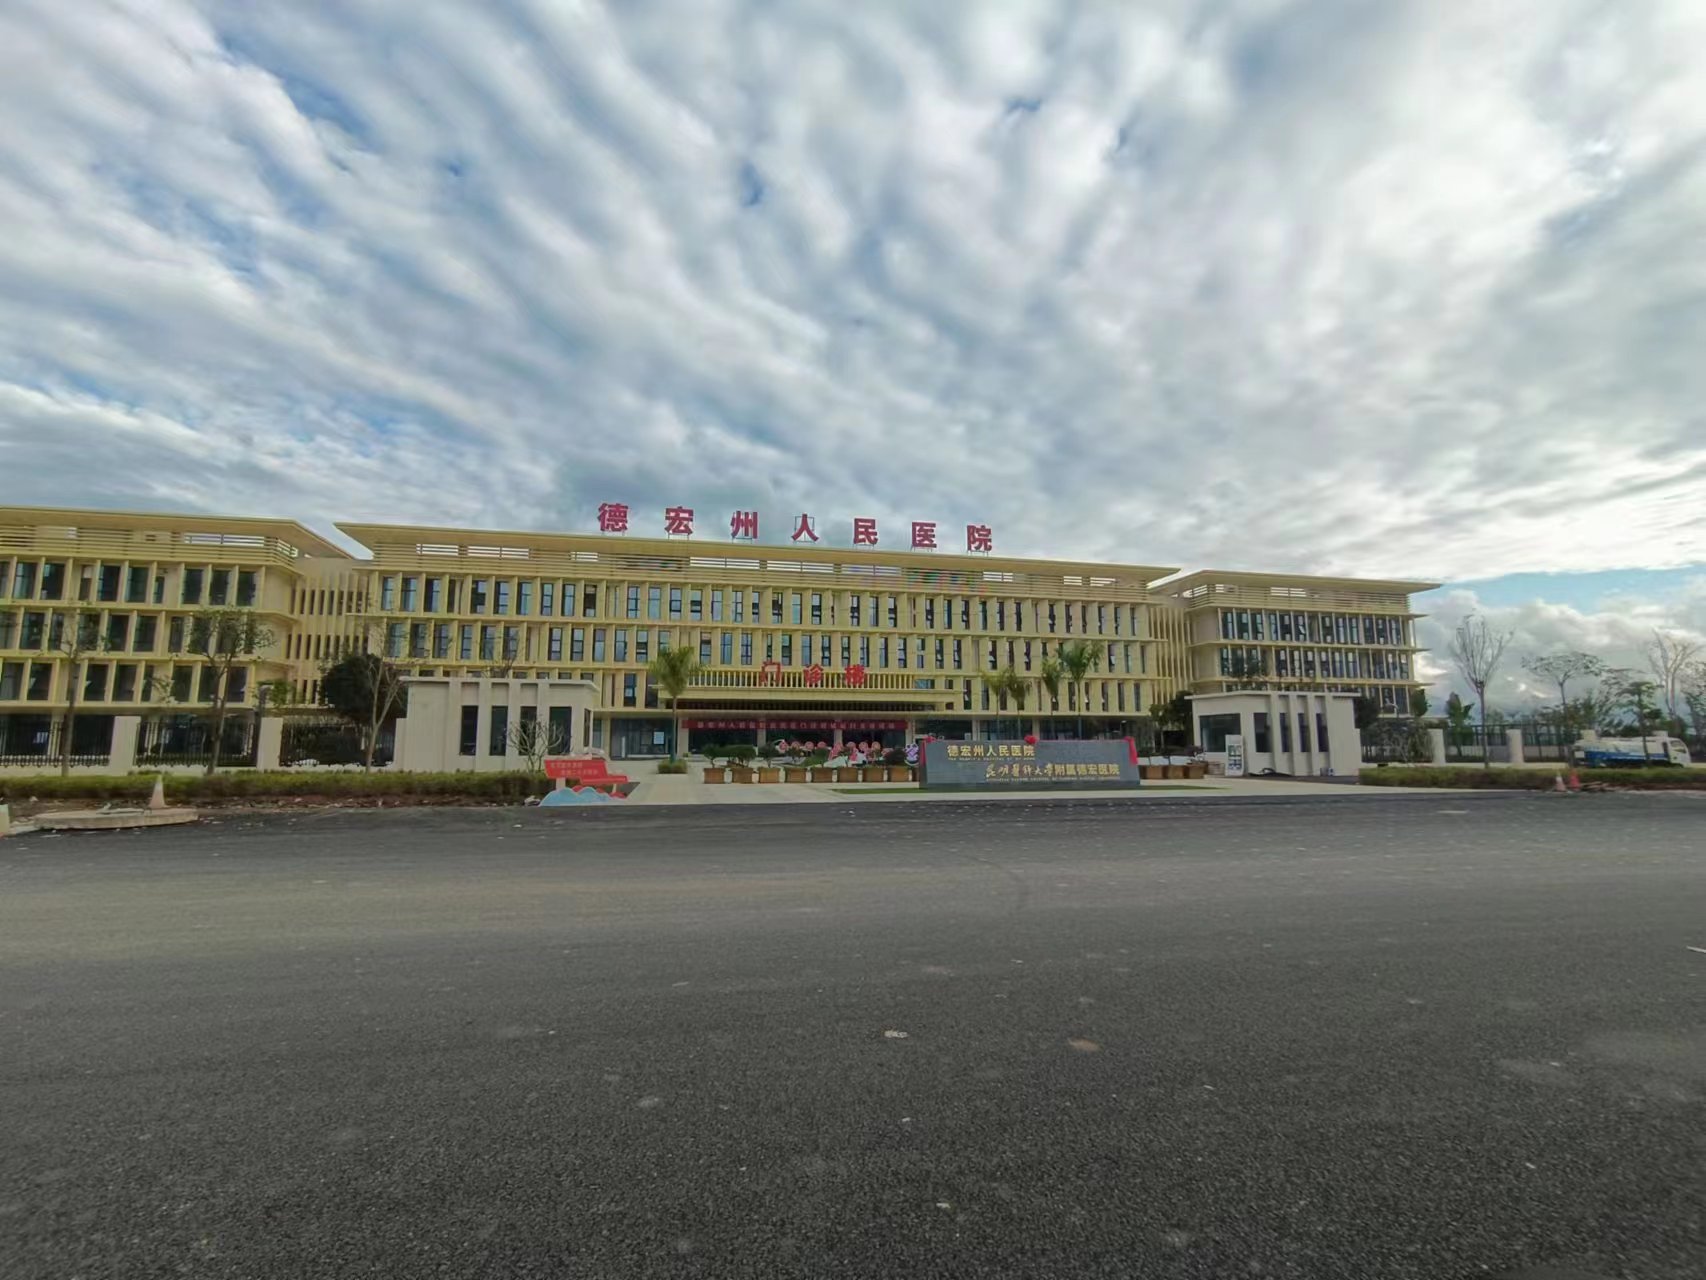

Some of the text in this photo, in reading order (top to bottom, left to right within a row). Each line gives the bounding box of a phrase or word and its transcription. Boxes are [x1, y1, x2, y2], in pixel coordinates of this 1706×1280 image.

[597, 502, 993, 552] 德宏州人民医院
[947, 744, 1035, 757] 德宏州人民医院
